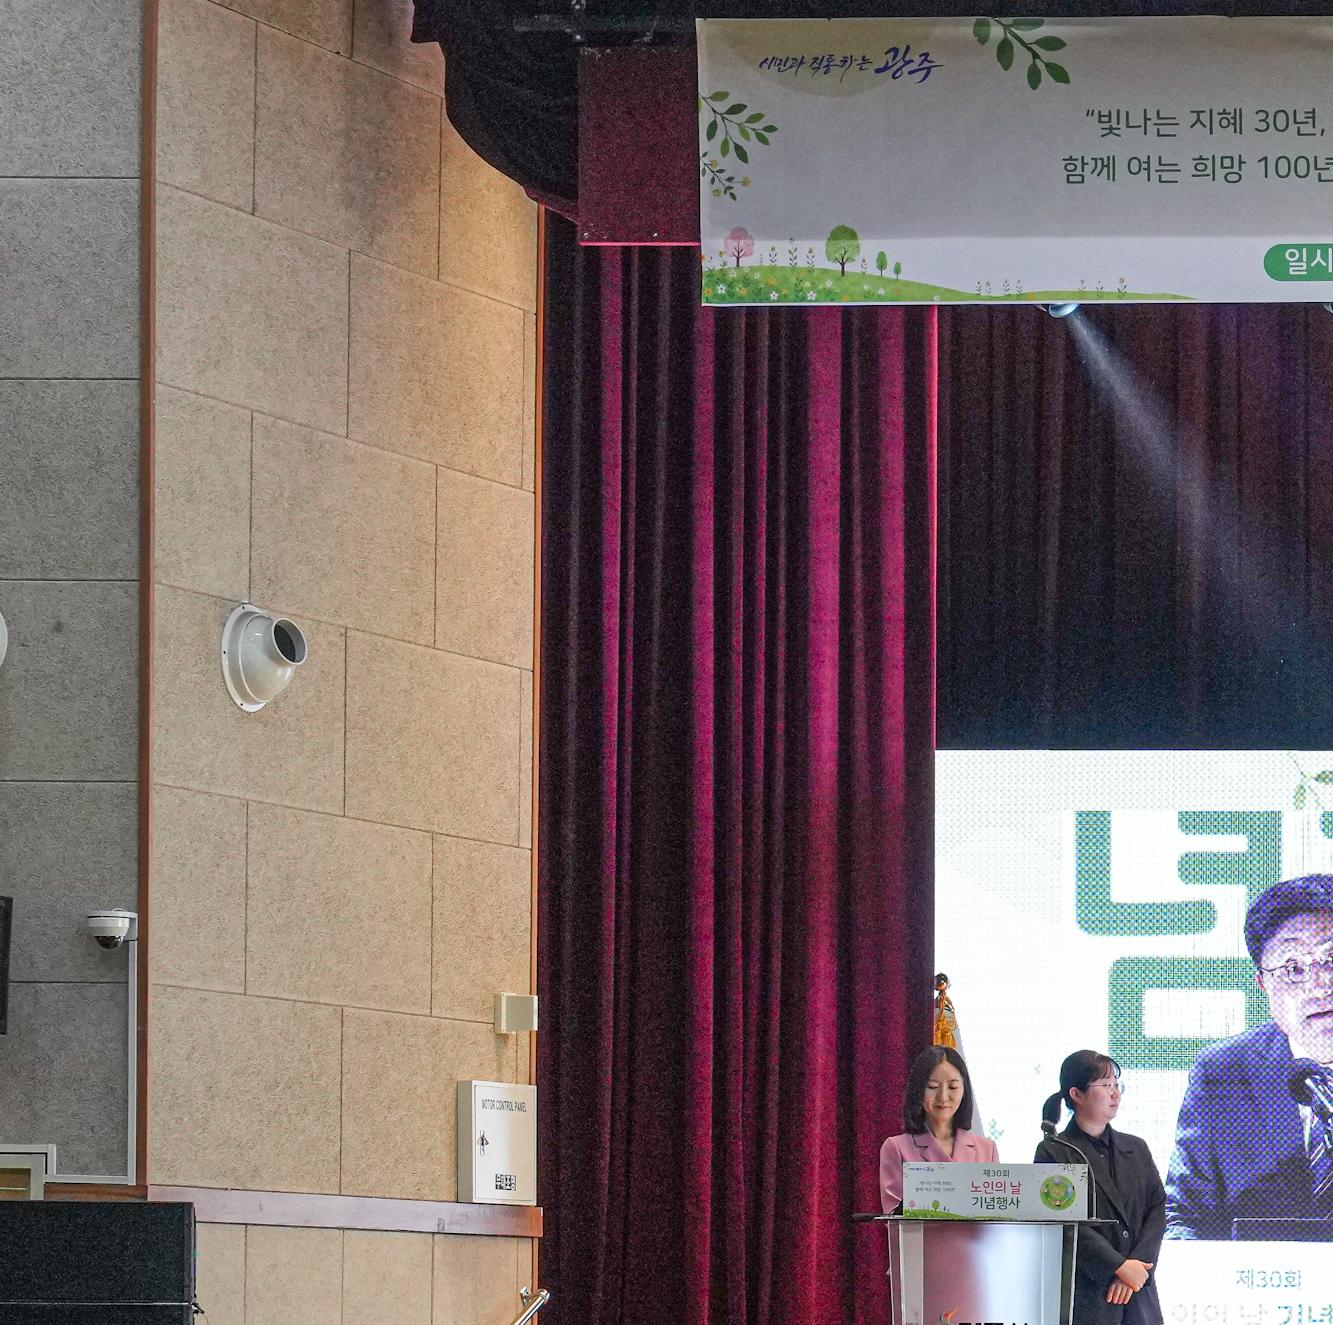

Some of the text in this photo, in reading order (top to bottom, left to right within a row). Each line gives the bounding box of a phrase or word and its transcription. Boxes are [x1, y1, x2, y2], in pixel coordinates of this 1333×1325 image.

[874, 44, 944, 84] 광주
[1188, 106, 1246, 137] 지혜
[1253, 106, 1328, 138] 30년,
[1061, 154, 1118, 185] 함께
[1126, 154, 1183, 185] 여는
[1190, 153, 1246, 185] 희망
[514, 1101, 527, 1113] PANEL
[983, 1169, 1010, 1178] 제30회
[970, 1181, 1007, 1194] 노인의
[1010, 1181, 1022, 1194] 날
[972, 1196, 1021, 1211] 기념행사
[1235, 1269, 1302, 1290] 제30회
